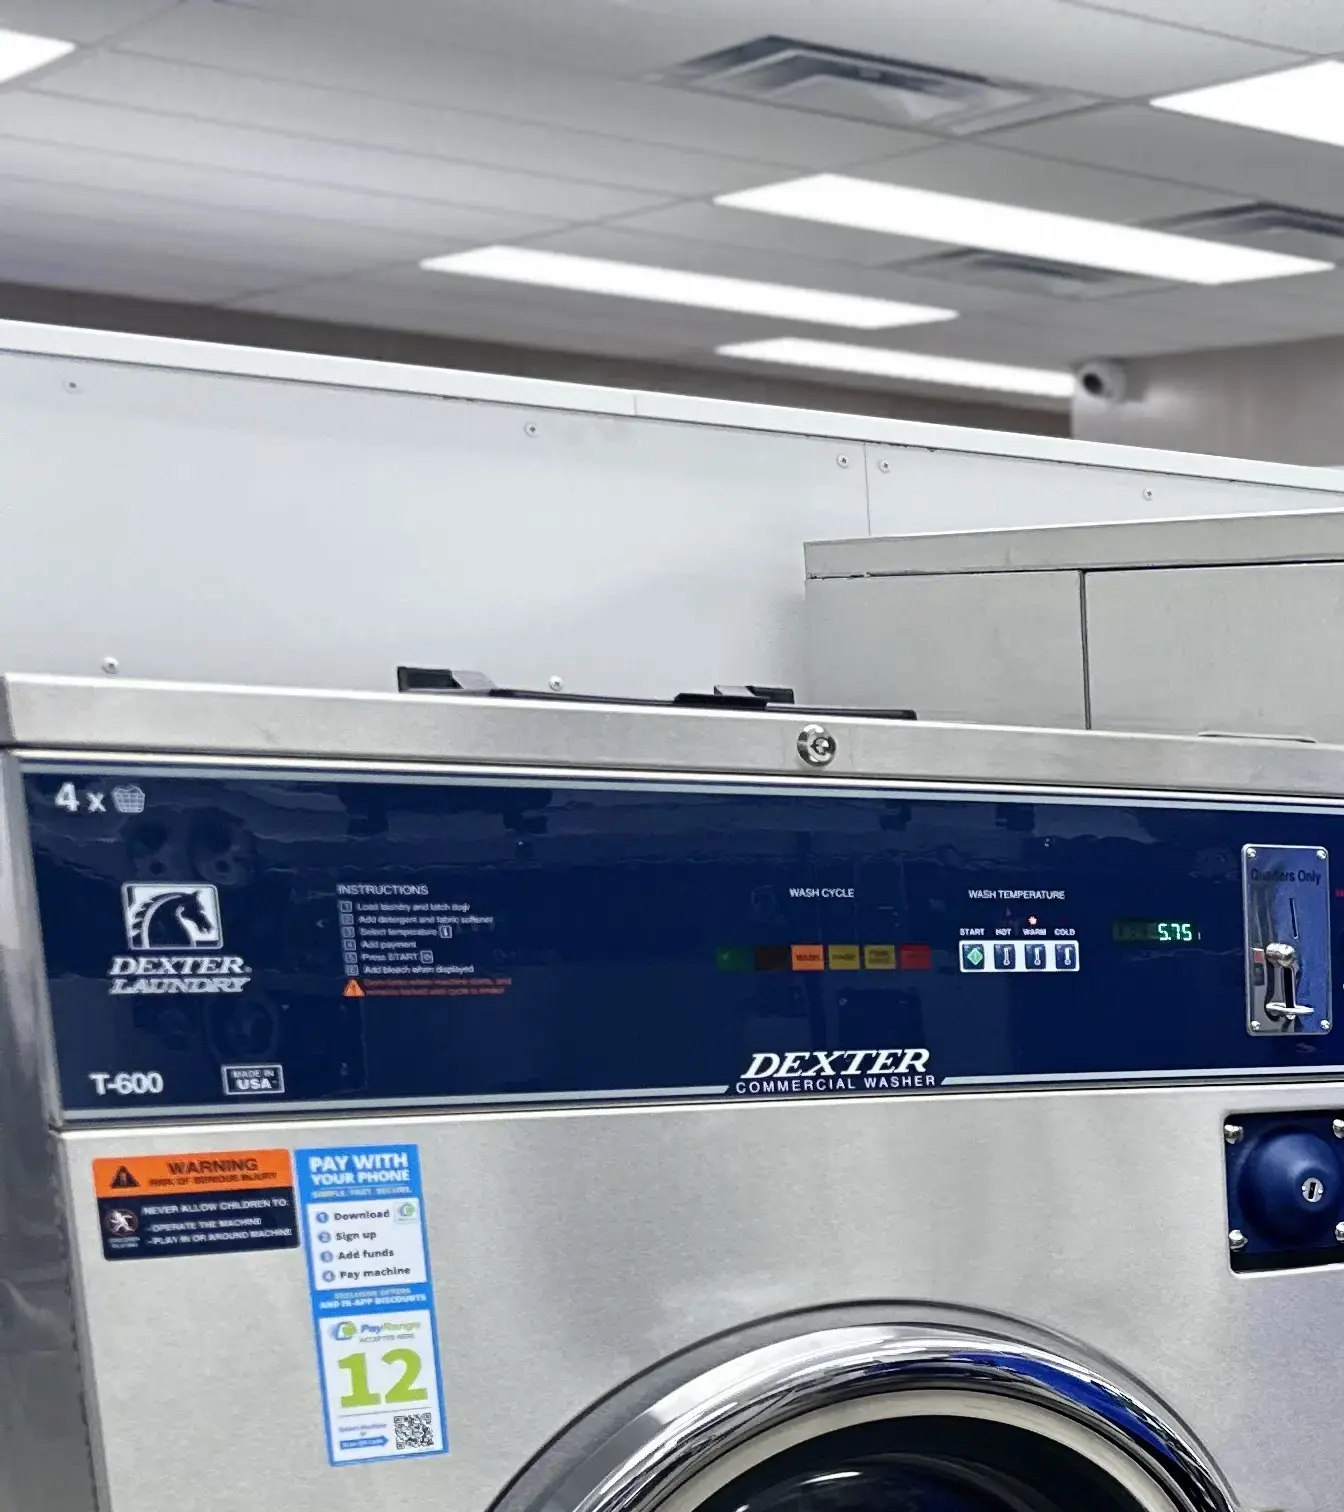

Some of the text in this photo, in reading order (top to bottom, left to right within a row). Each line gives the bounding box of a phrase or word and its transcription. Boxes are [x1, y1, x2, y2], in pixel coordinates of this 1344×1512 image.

[55, 783, 106, 812] 4 x
[1298, 869, 1321, 886] Only
[338, 884, 429, 895] INSTRUCTIONS
[789, 888, 854, 898] WASH CYCLE
[968, 890, 1065, 900] WASH TEMPERATURE
[960, 928, 985, 936] START
[995, 928, 1012, 936] HOT
[1054, 928, 1076, 936] COLD
[1157, 923, 1192, 941] 5.75
[380, 941, 416, 949] payment
[388, 953, 418, 961] START
[110, 956, 246, 976] DEXTER
[109, 977, 251, 994] LAUNDRY
[740, 1048, 930, 1079] DEXTER
[232, 1069, 274, 1078] MADE IN
[89, 1071, 164, 1095] T-600
[237, 1078, 273, 1090] USA
[735, 1075, 936, 1094] COMMERCIAL WASHER
[168, 1158, 258, 1175] WARNING
[309, 1152, 408, 1172] PAY WITH
[311, 1170, 410, 1185] YOUR PHONE
[142, 1205, 178, 1215] NEVER
[180, 1203, 217, 1213] ALLOW
[220, 1200, 270, 1210] CHILDREN
[334, 1210, 390, 1221] Download
[199, 1221, 216, 1229] THE
[219, 1218, 262, 1227] MACHINE
[192, 1233, 207, 1242] OR
[208, 1231, 249, 1240] AROUND
[250, 1228, 292, 1237] MACHINE
[336, 1232, 376, 1242] Sign up
[338, 1249, 394, 1260] Add funds
[340, 1267, 411, 1280] Pay machine
[337, 1348, 428, 1408] 12
